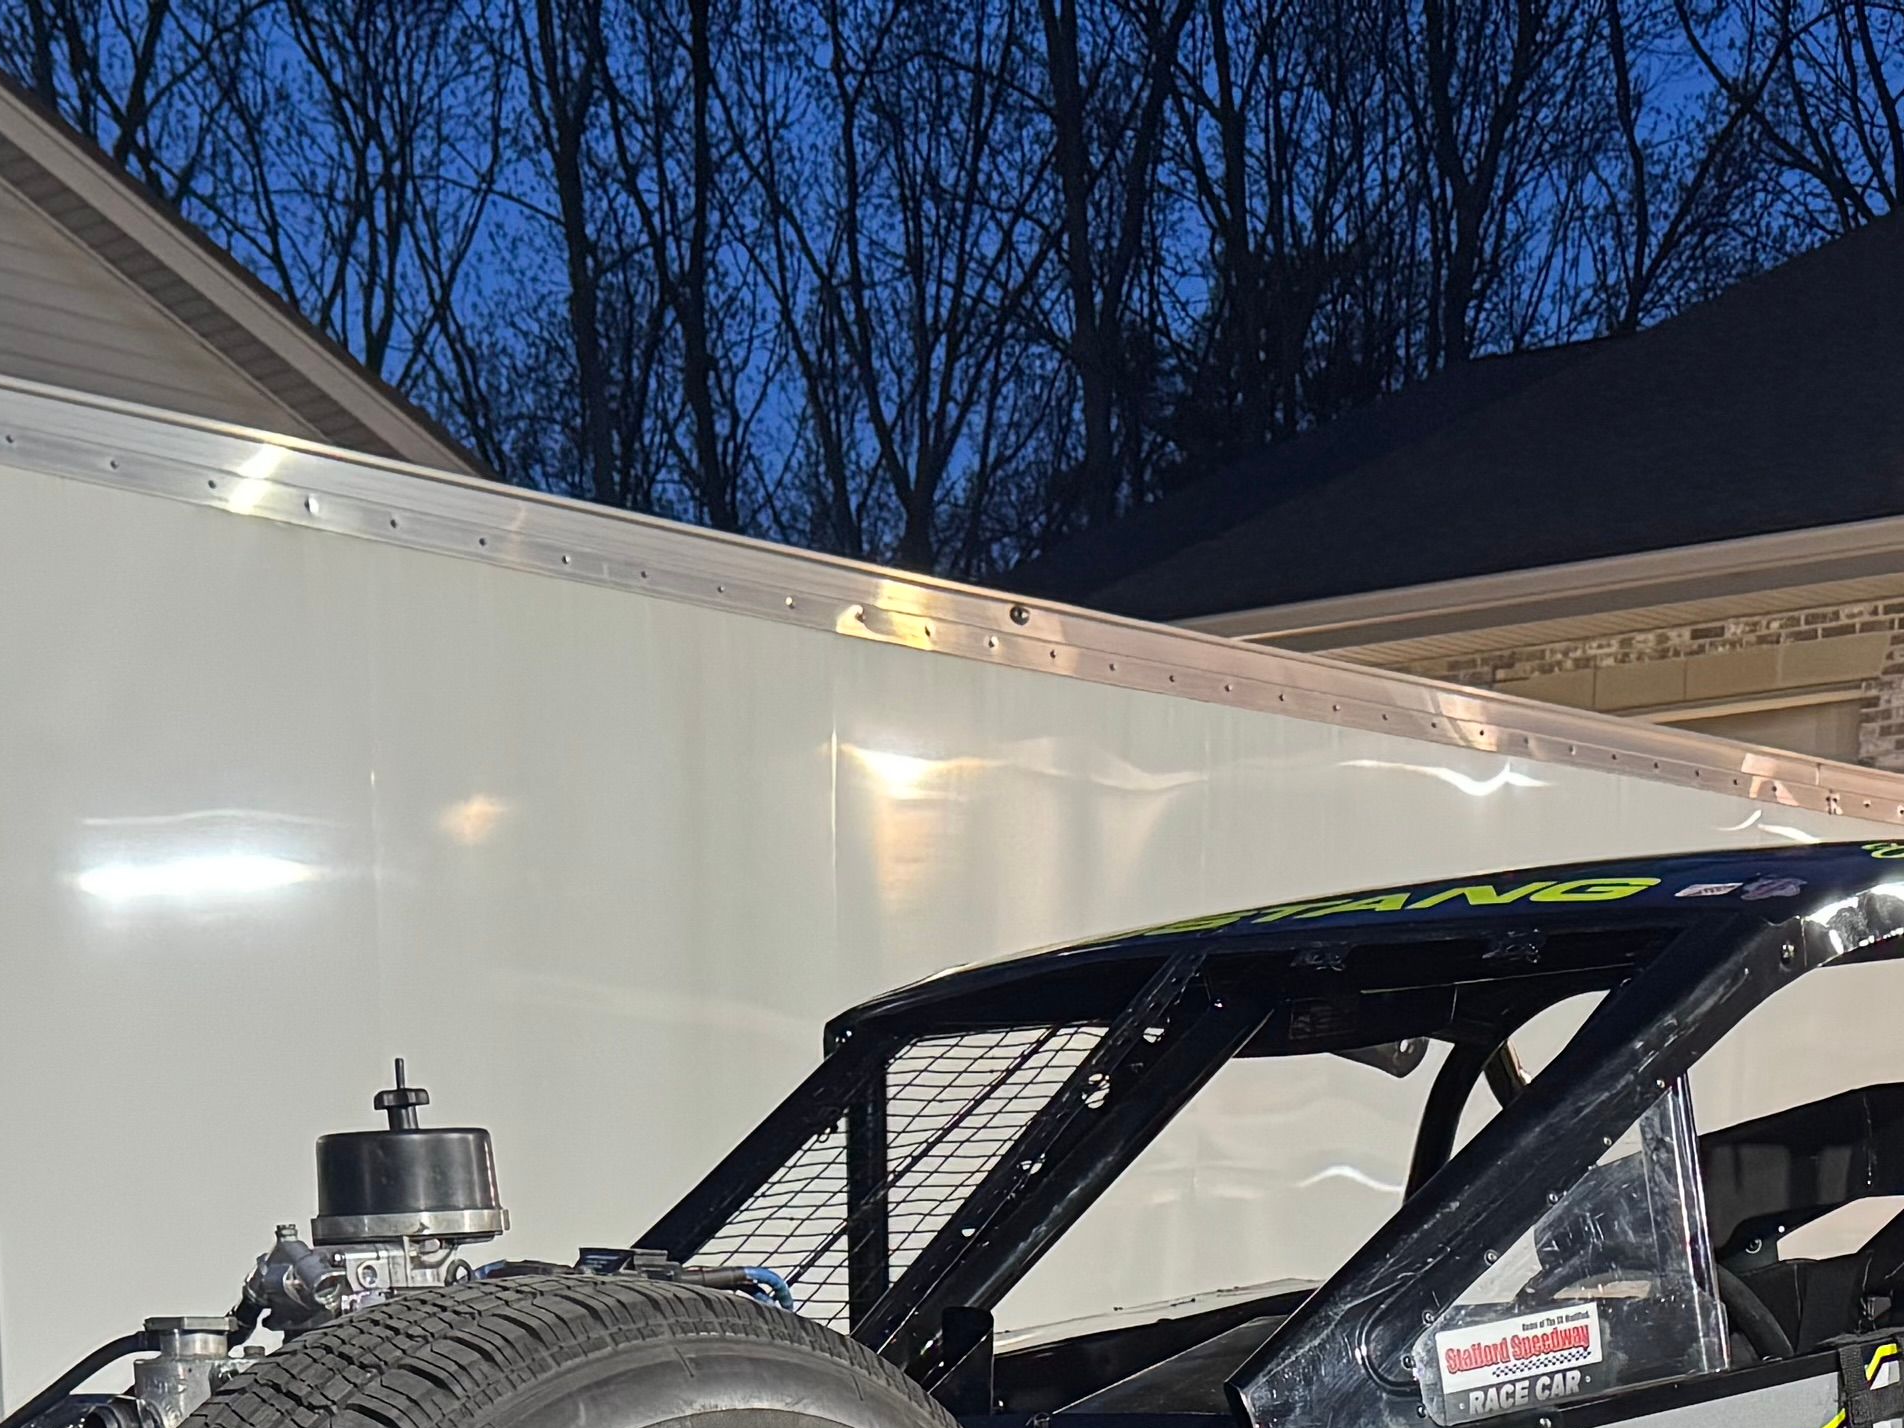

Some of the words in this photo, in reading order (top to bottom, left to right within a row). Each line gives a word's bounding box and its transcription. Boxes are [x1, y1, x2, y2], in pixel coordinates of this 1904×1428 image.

[1445, 1337, 1511, 1375] Stafford
[1510, 1324, 1591, 1361] Speedway
[1468, 1380, 1530, 1416] RACE
[1535, 1369, 1583, 1401] CAR
